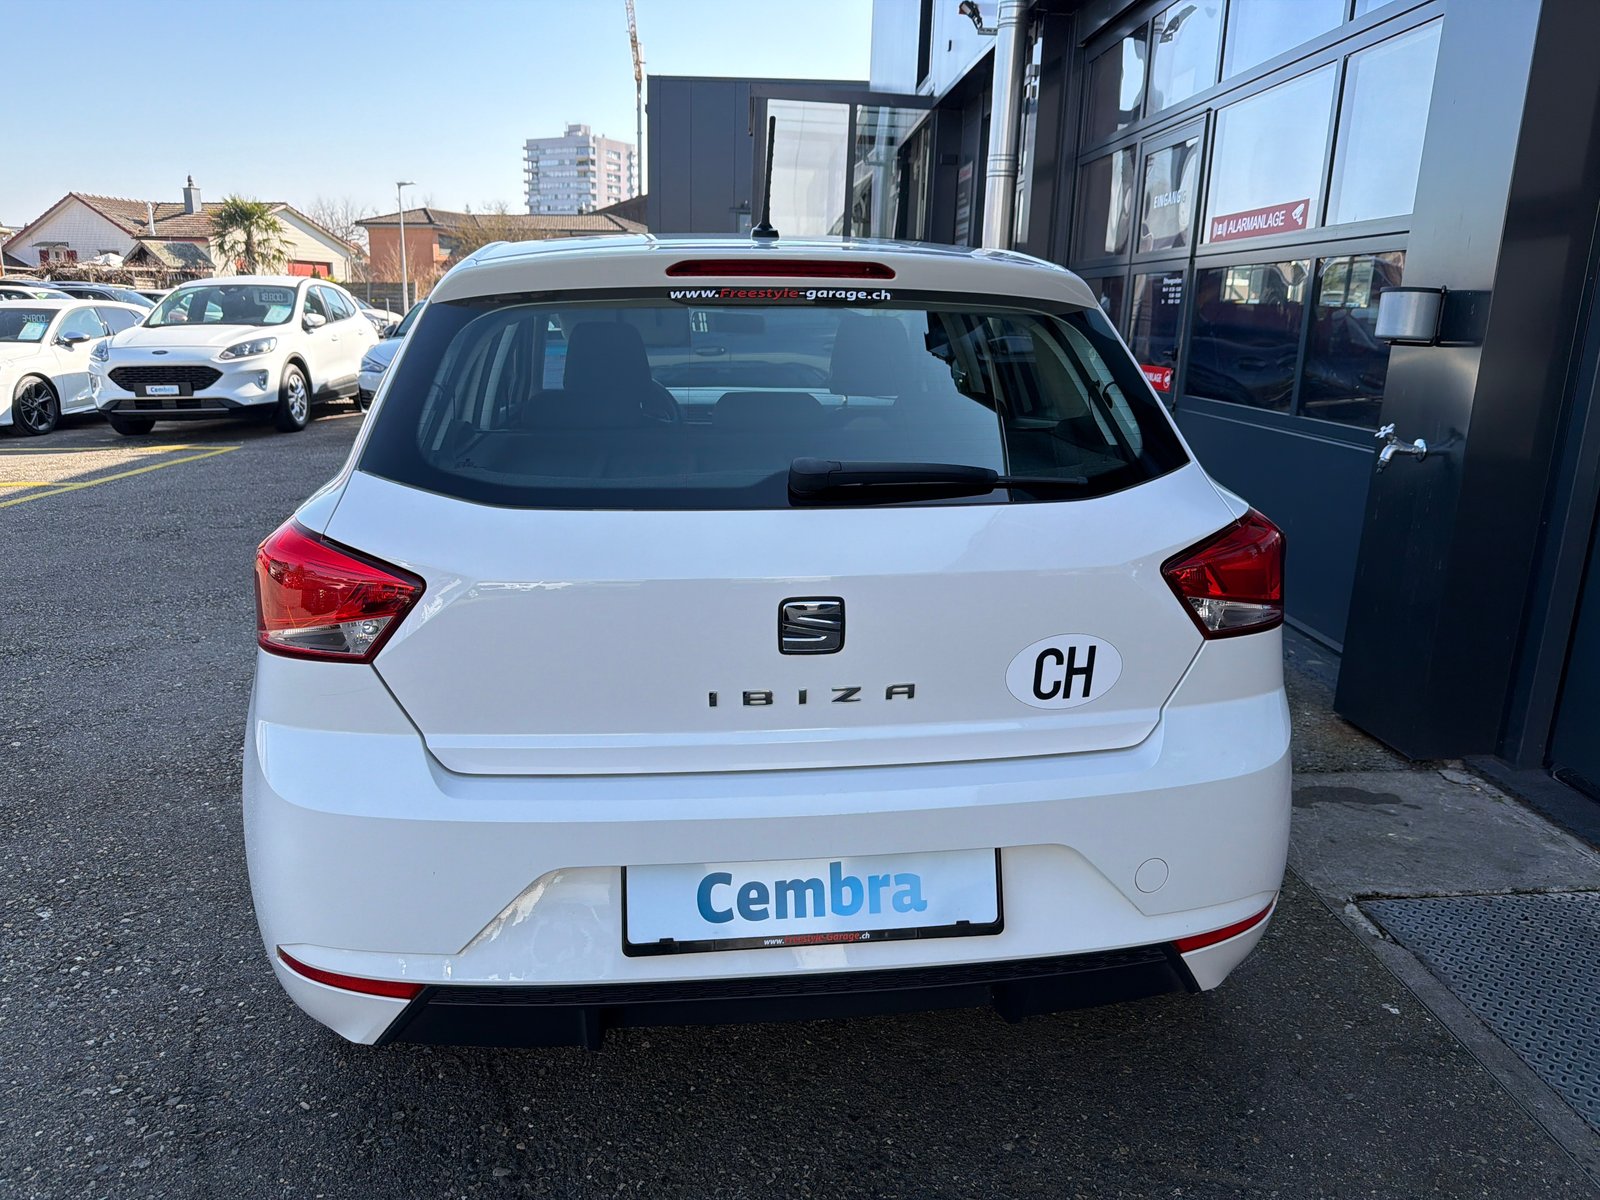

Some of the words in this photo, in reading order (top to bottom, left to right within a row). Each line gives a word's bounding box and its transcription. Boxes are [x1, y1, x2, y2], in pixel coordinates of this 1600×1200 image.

[1228, 211, 1286, 234] ALARMANLAGE
[669, 287, 892, 301] www.Freestyle-garage.ch
[1032, 645, 1097, 700] CH
[708, 683, 917, 707] IBIZA
[696, 861, 928, 924] Cembra
